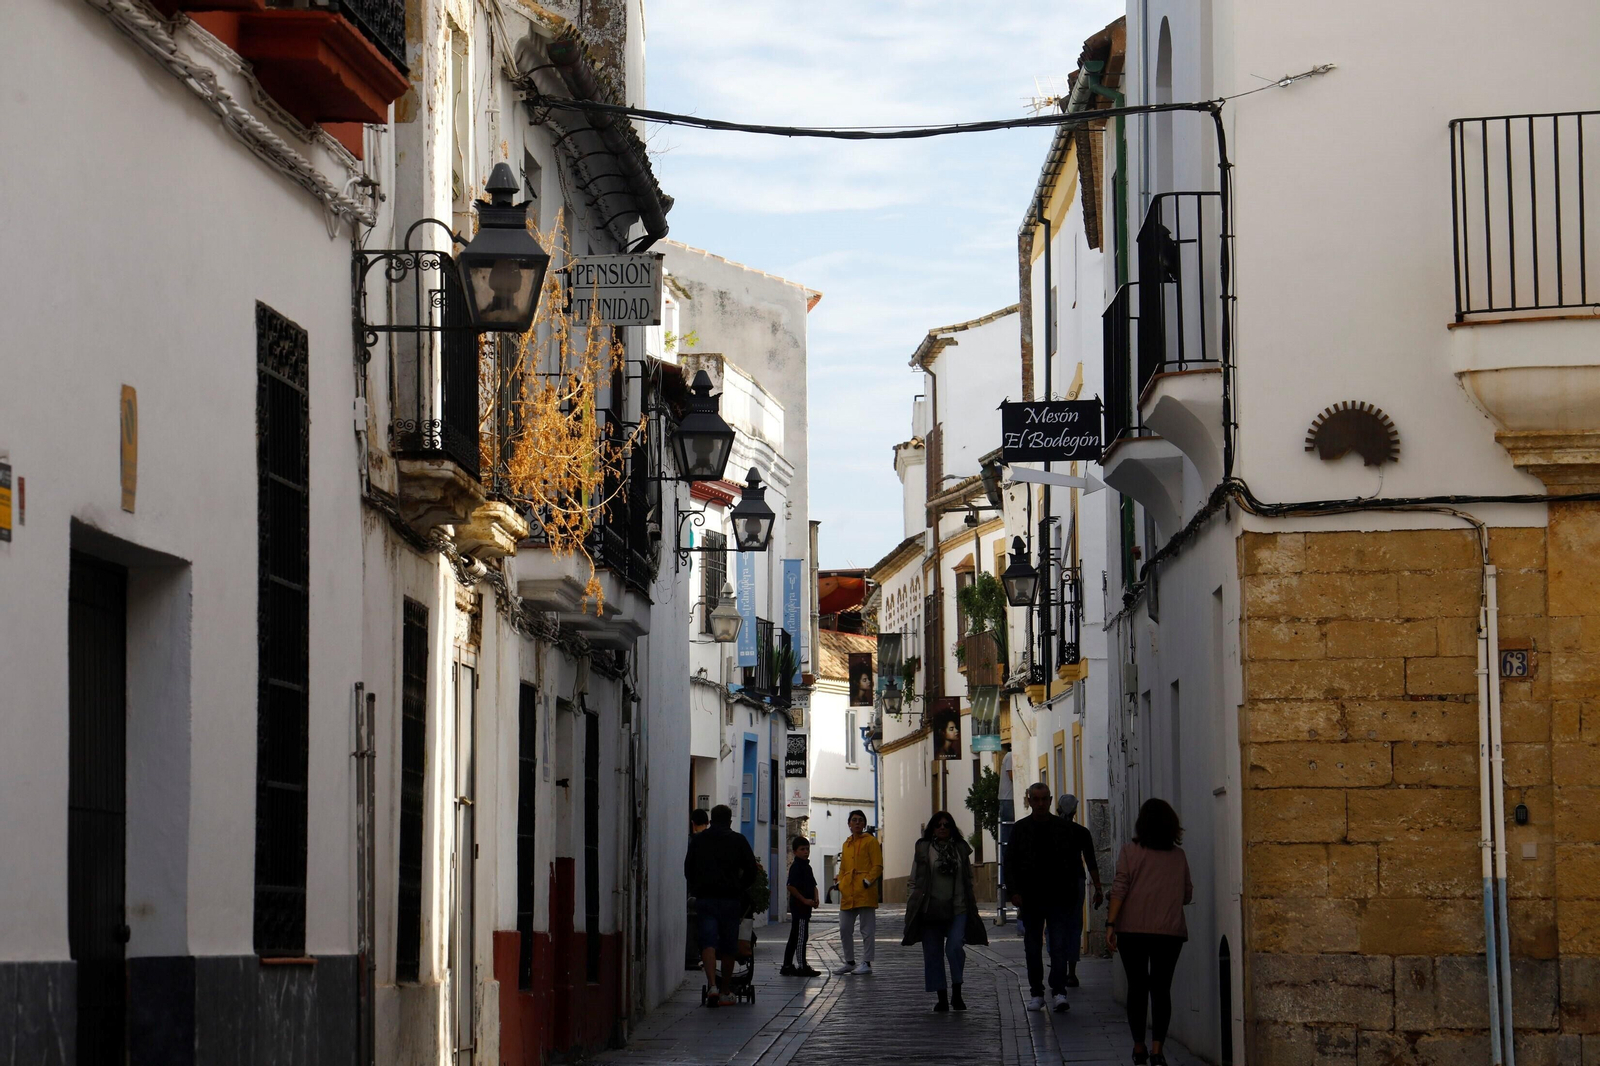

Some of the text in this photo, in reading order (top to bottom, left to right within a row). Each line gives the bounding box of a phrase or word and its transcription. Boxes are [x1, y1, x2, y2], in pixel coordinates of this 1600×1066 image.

[576, 257, 651, 284] PENSIÓN
[1023, 406, 1079, 424] Mesón
[1004, 427, 1099, 457] El Bodegón
[1502, 652, 1526, 676] 63
